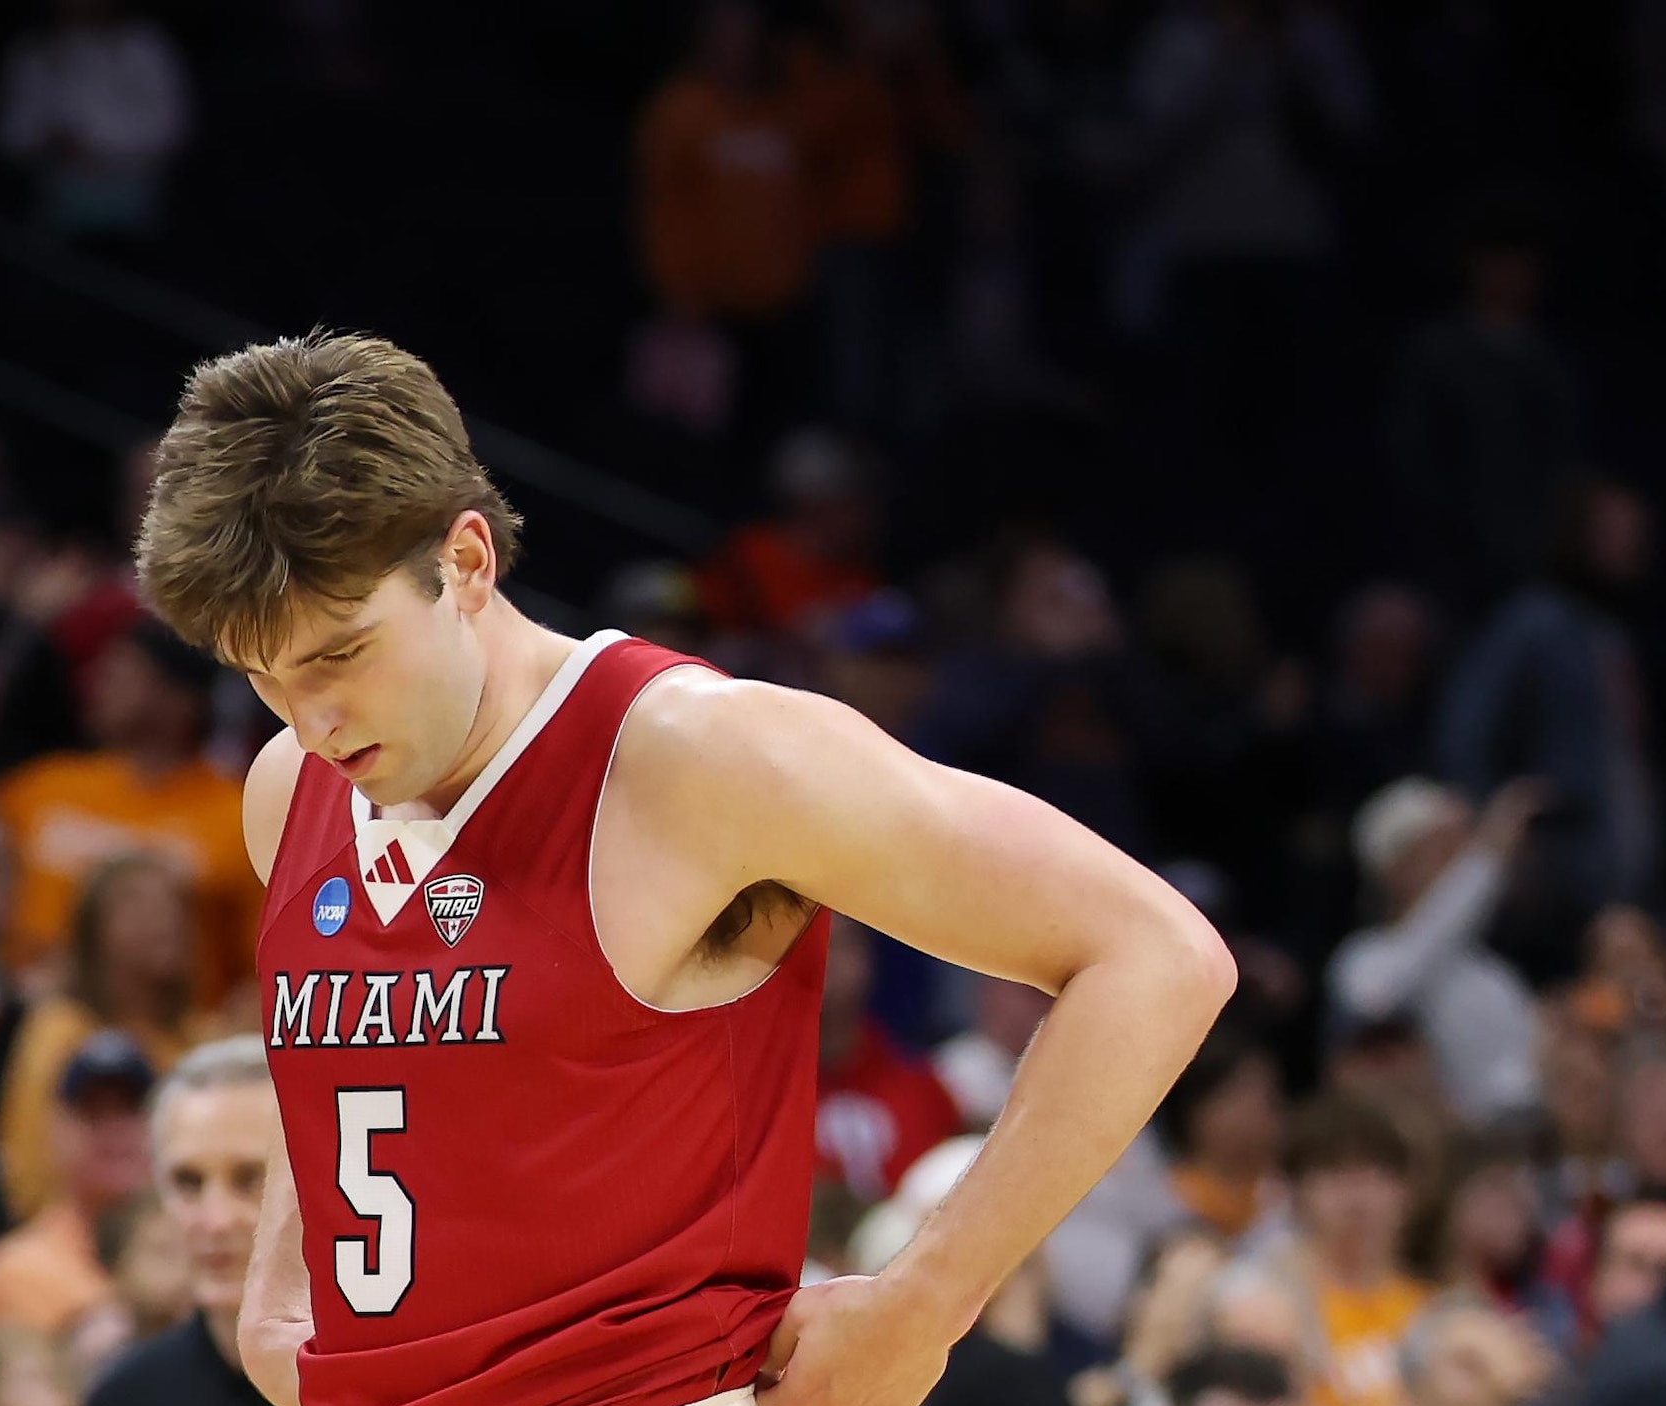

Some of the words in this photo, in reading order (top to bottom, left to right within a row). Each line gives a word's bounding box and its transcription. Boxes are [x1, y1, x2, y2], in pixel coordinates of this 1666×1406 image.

[317, 904, 348, 922] NCAA
[430, 897, 478, 917] MAC
[269, 965, 510, 1048] MIAMI
[333, 1085, 416, 1317] 5
